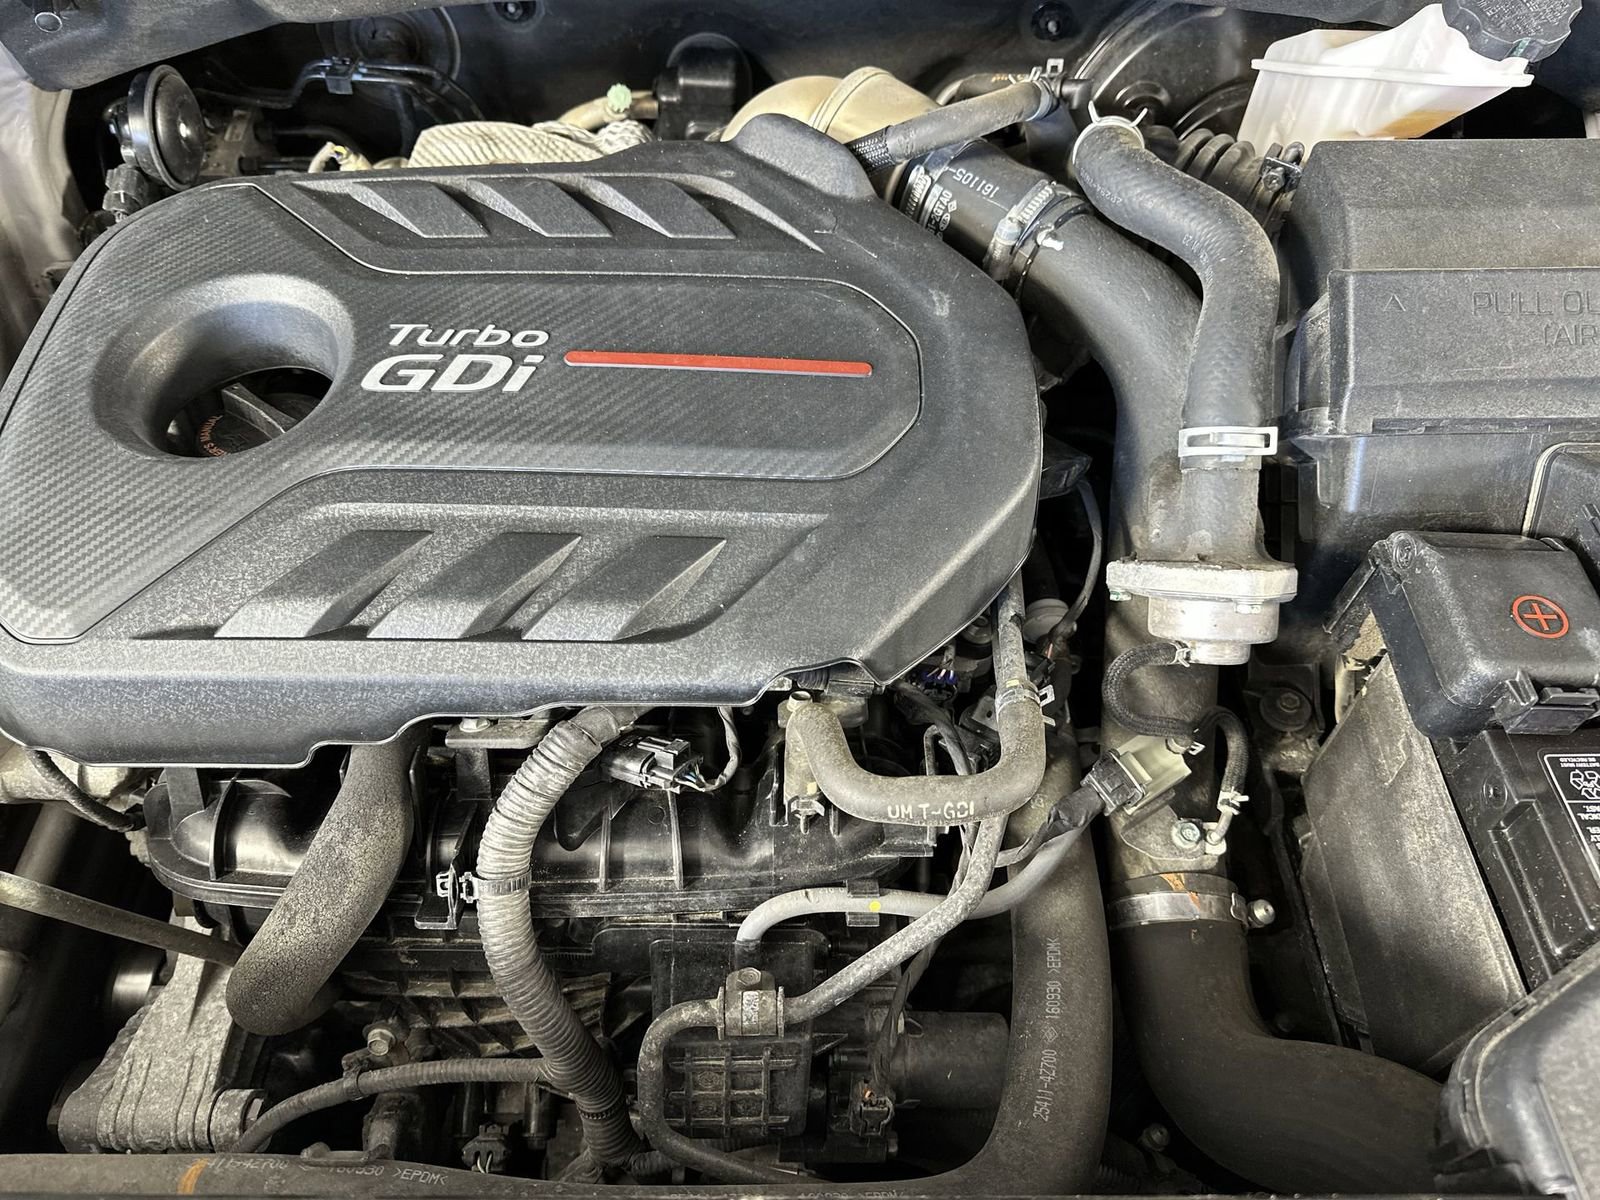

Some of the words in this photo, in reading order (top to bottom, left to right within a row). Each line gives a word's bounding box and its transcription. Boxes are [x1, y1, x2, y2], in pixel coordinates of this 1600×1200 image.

[1472, 290, 1554, 317] PULL
[389, 323, 549, 348] Turbo
[360, 353, 546, 393] GDi
[887, 803, 913, 819] UM
[1045, 980, 1062, 1020] 160930
